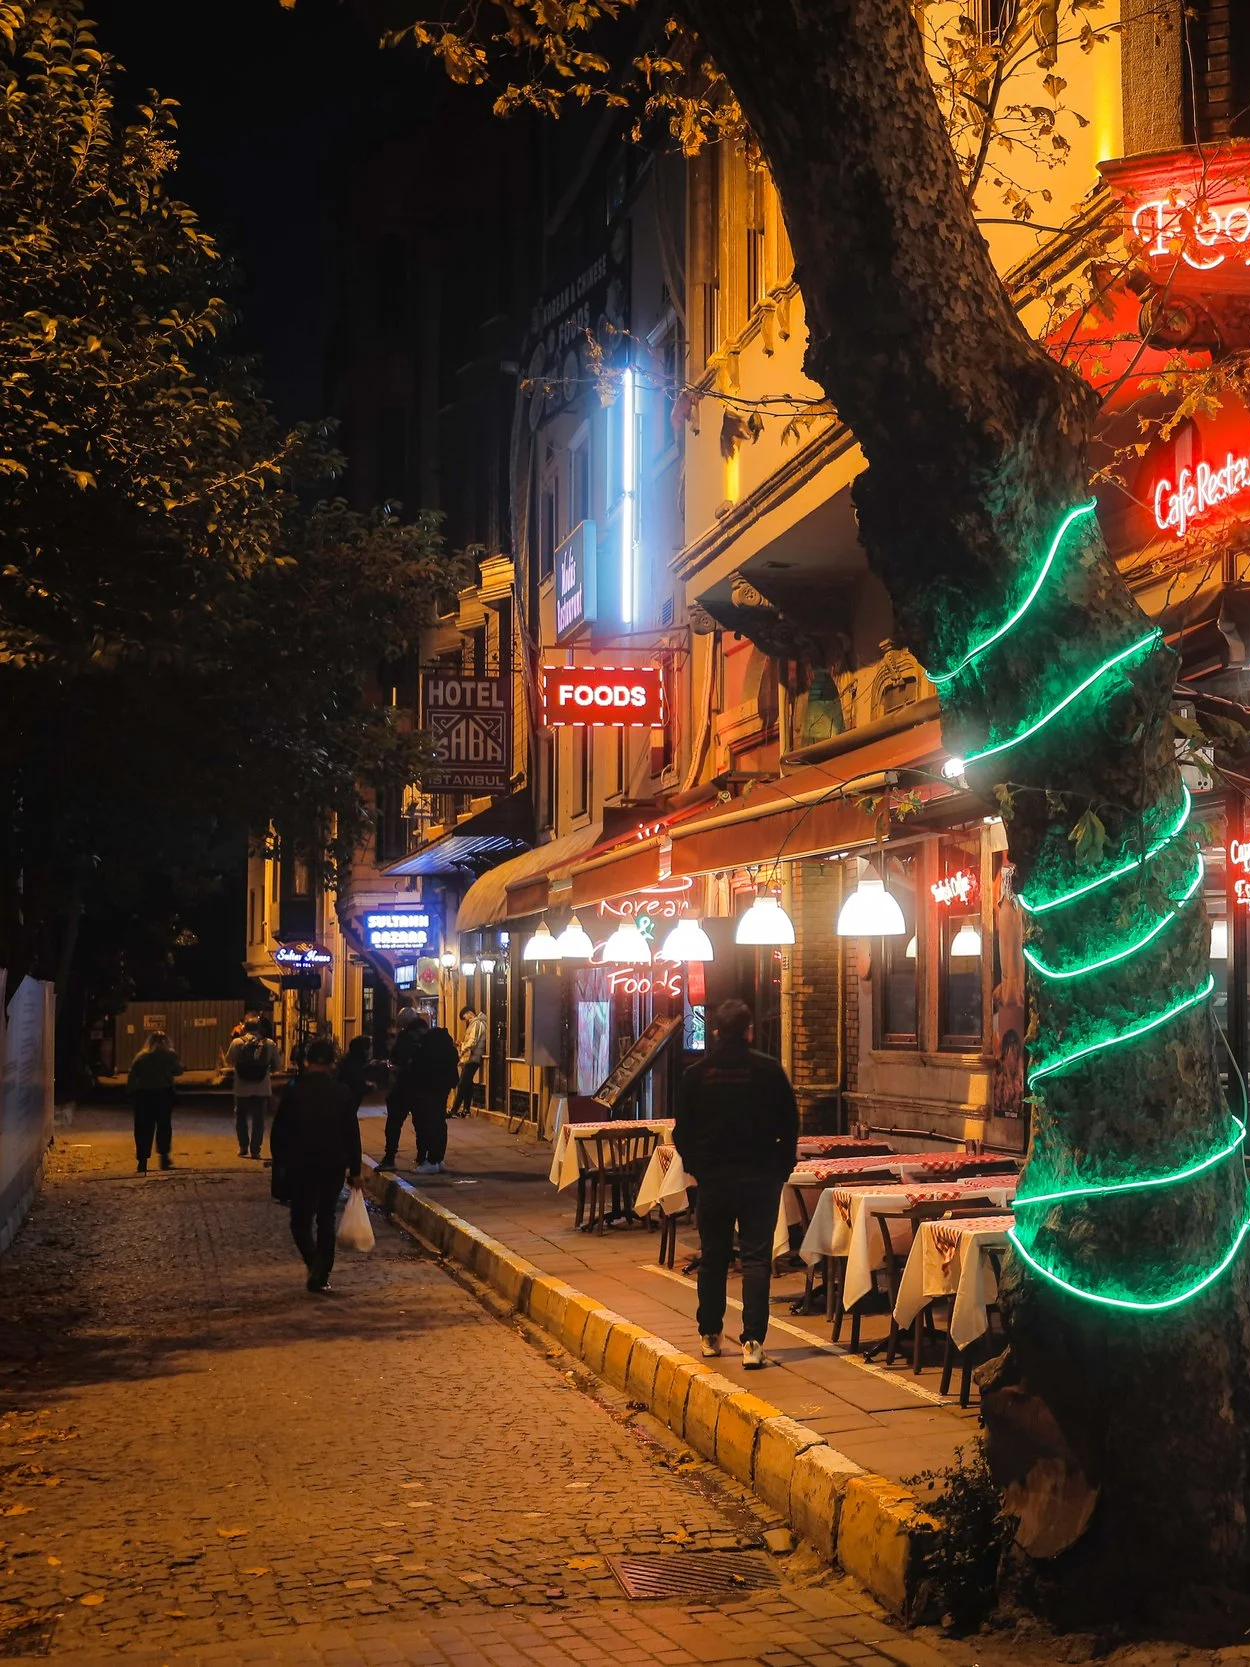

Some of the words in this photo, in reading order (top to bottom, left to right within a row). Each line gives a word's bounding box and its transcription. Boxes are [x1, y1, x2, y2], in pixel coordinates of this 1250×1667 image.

[577, 253, 607, 299] CHINESE
[559, 302, 590, 349] FOODS
[1154, 467, 1197, 537] Cafe
[428, 680, 504, 708] HOTEL
[559, 684, 648, 707] FOODS
[435, 716, 503, 763] SABA
